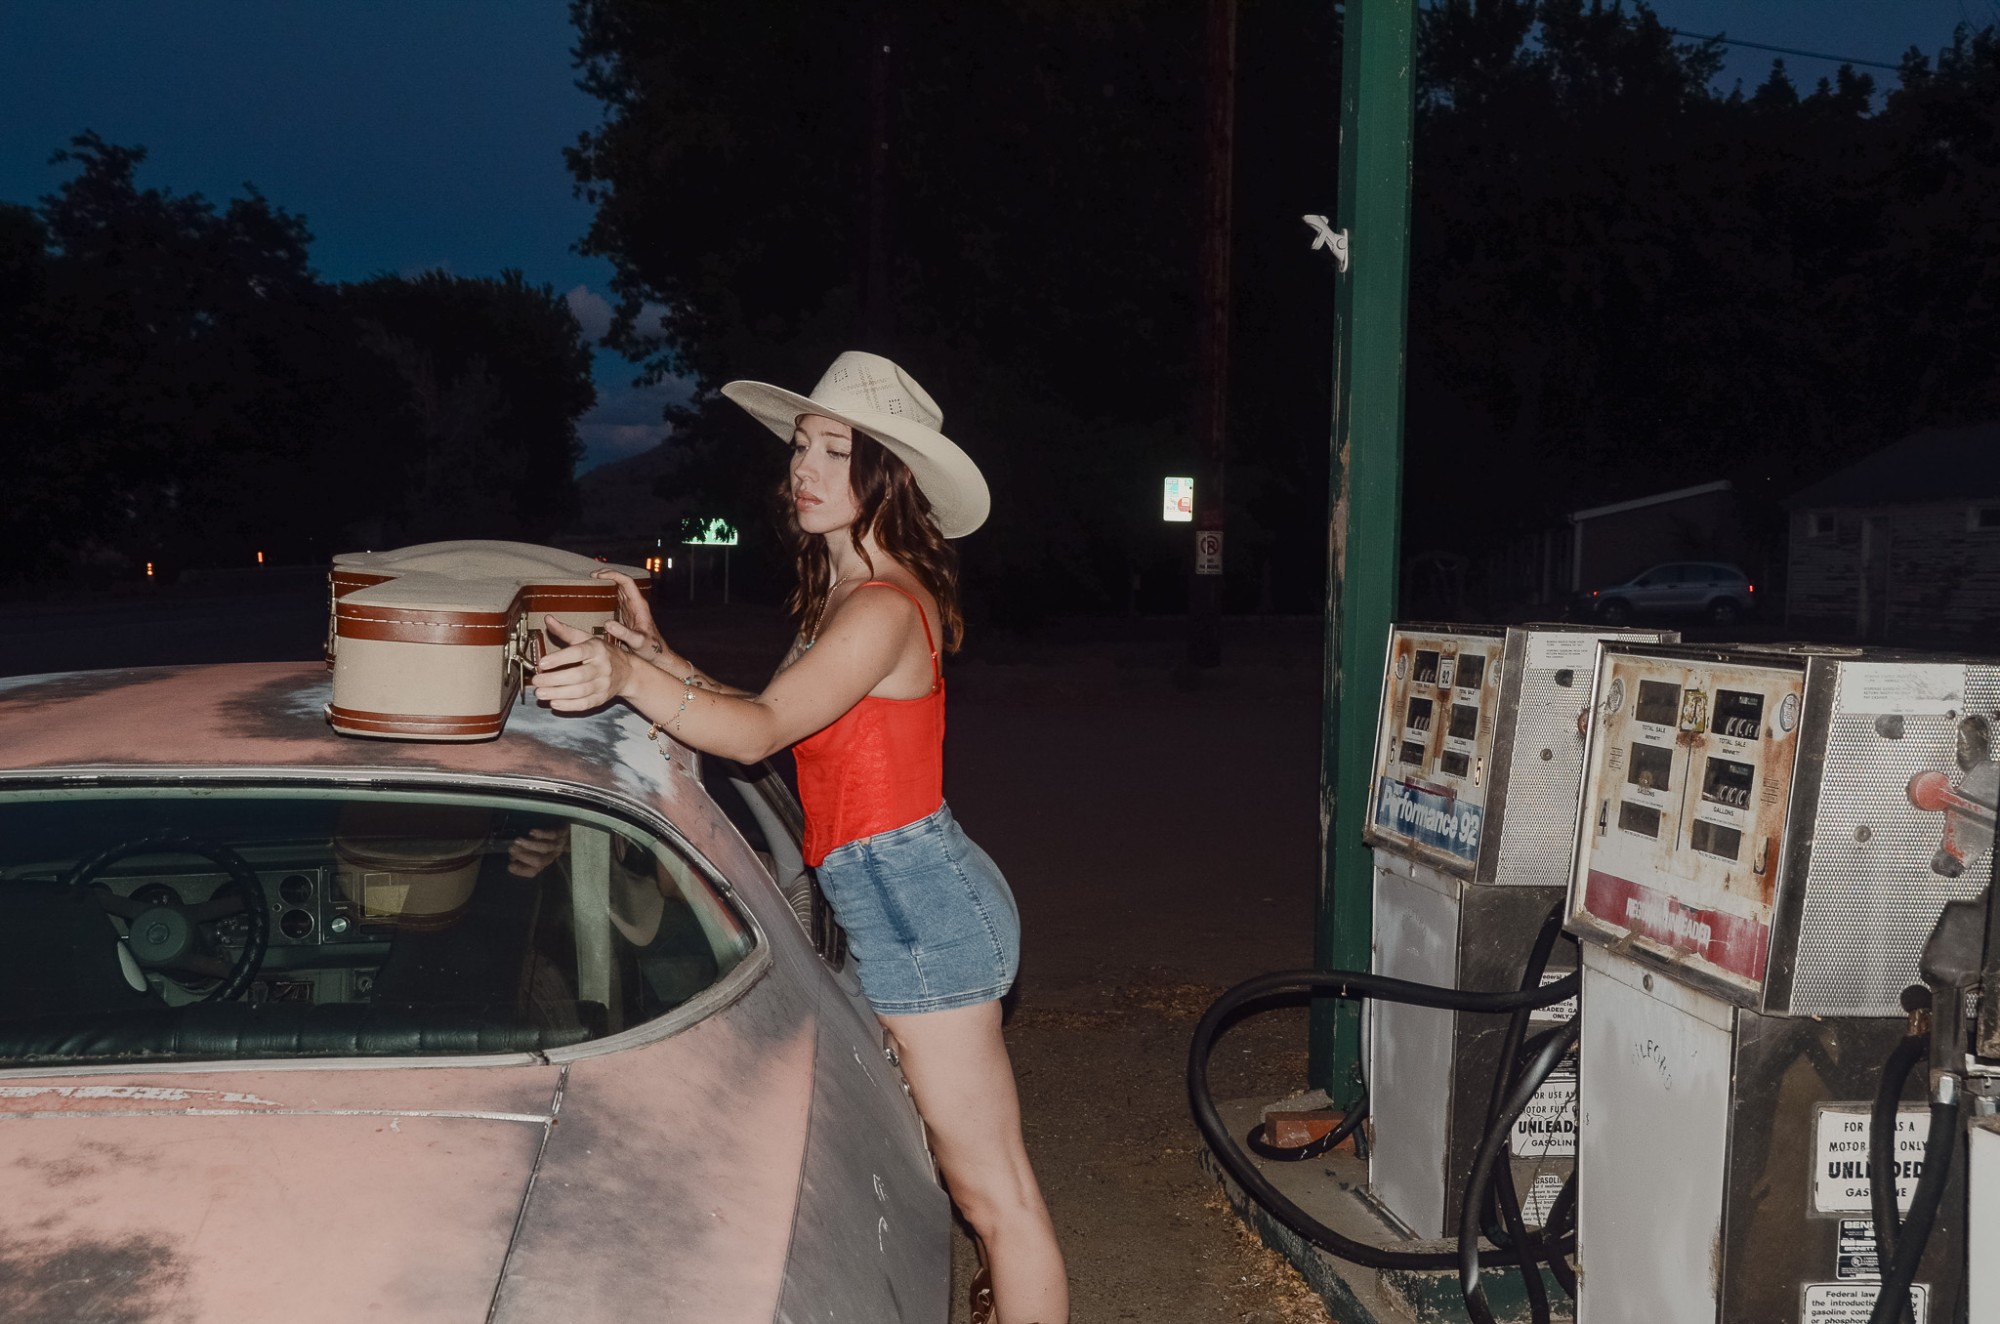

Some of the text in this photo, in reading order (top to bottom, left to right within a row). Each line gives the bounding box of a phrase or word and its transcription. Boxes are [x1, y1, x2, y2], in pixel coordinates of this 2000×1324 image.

[1441, 670, 1450, 684] 92
[1655, 726, 1666, 734] SALE
[1719, 737, 1746, 748] TOTAL SALE
[1713, 806, 1734, 817] GALLONS
[1459, 811, 1480, 846] 92
[1548, 1091, 1562, 1099] USE
[1518, 1120, 1574, 1134] UNLEAD
[1844, 1121, 1864, 1132] FOR
[1908, 1121, 1915, 1131] A
[1531, 1139, 1575, 1147] GASOLIN
[1829, 1141, 1866, 1152] MOTOR
[1826, 1290, 1876, 1298] Federal law
[1811, 1309, 1847, 1317] gasoline
